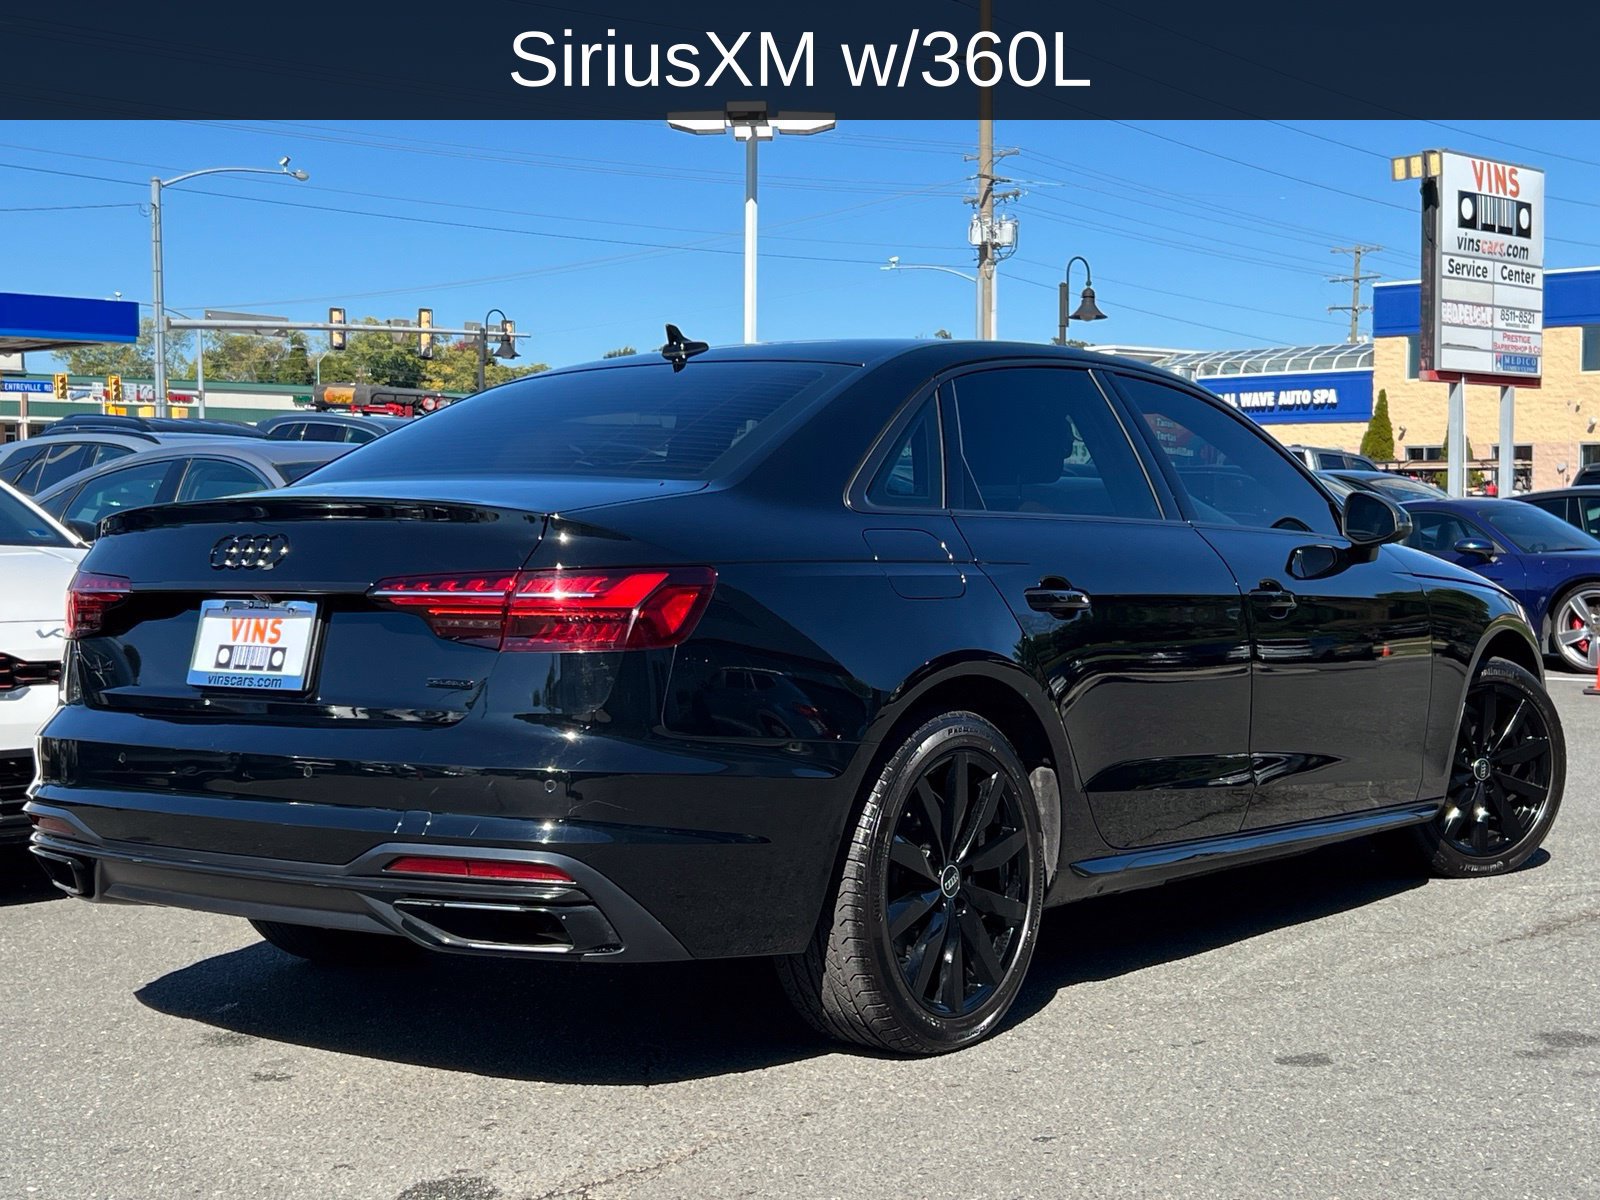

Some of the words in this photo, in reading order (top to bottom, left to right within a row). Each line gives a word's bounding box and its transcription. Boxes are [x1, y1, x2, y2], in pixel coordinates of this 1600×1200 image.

[1471, 160, 1520, 198] VINS
[1457, 232, 1529, 260] vinscars.com
[1447, 258, 1488, 279] Service
[1500, 265, 1536, 286] Center
[1500, 309, 1535, 324] 8511-8521
[1504, 356, 1537, 367] MEDICO
[1239, 391, 1275, 408] WAVE
[1278, 390, 1311, 405] AUTO
[1312, 388, 1338, 404] SPA
[230, 617, 283, 645] VINS
[207, 673, 282, 689] vinscars.com
